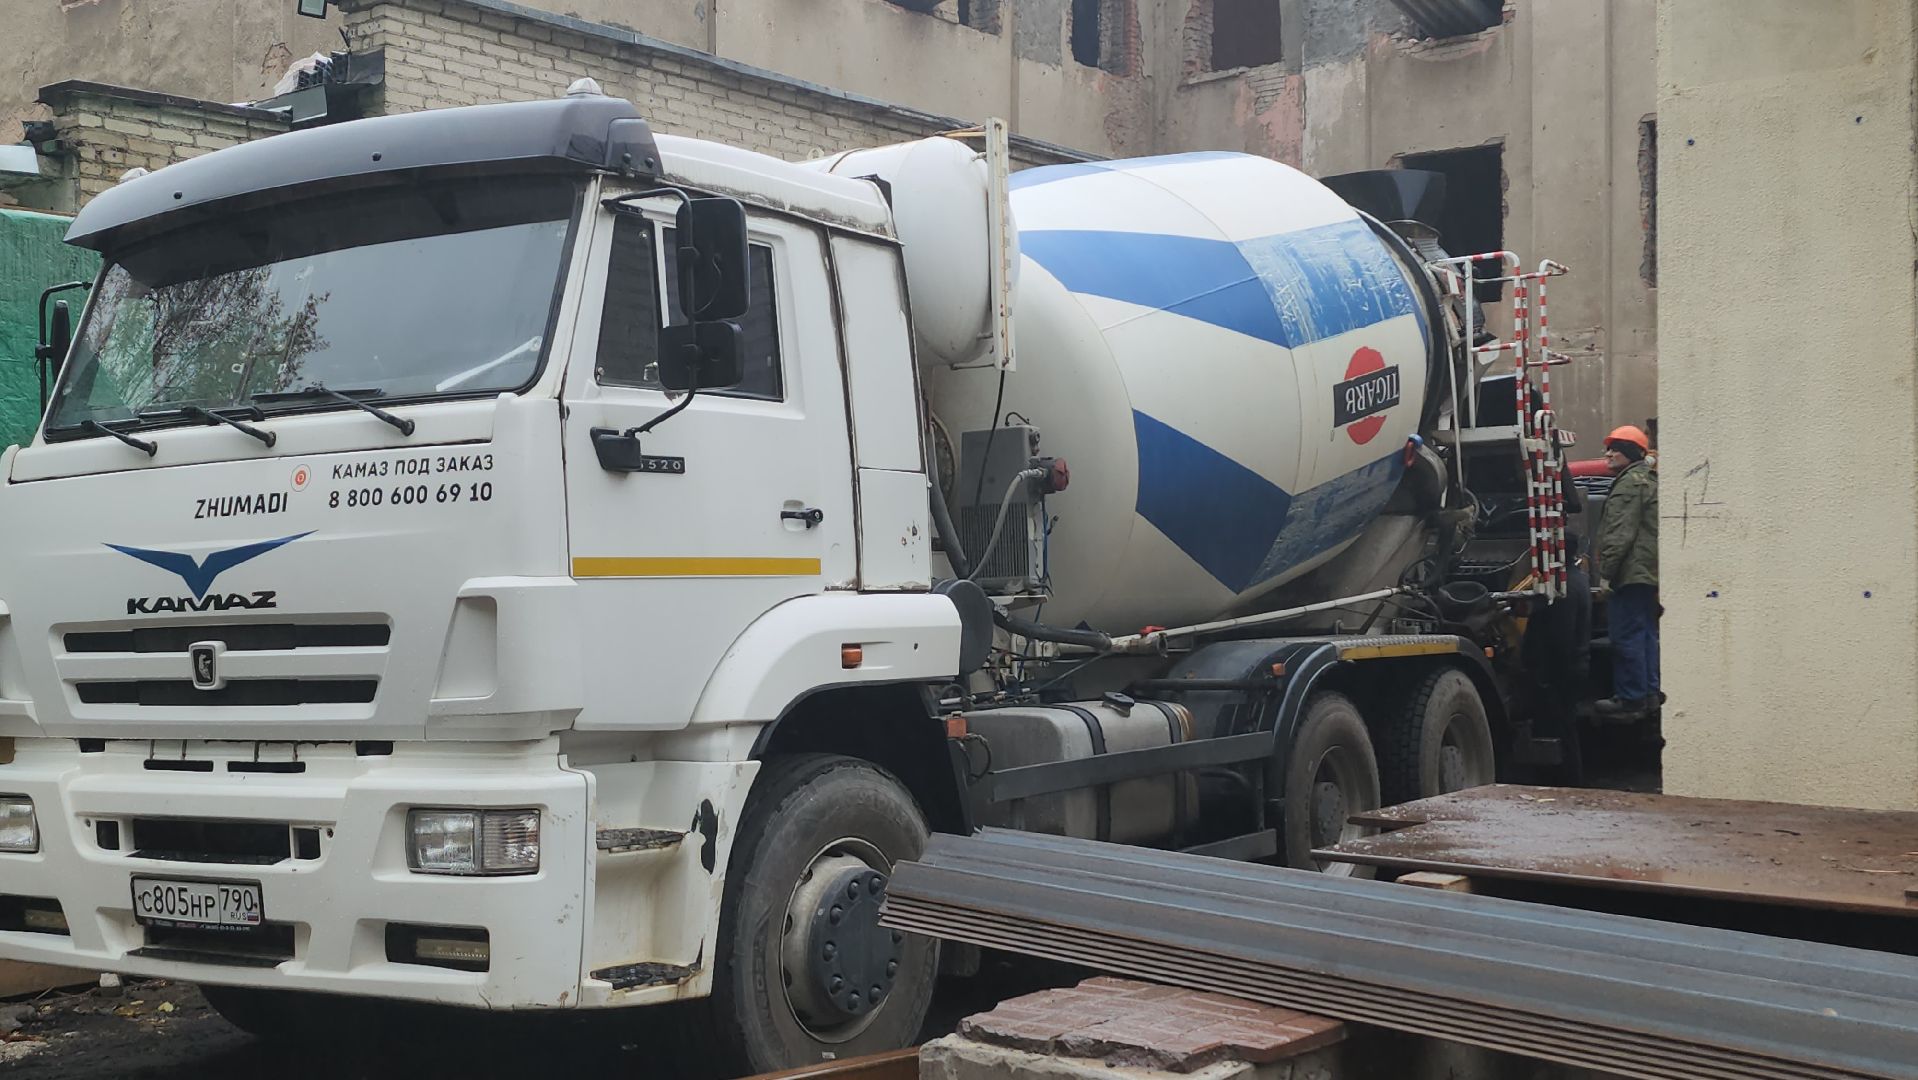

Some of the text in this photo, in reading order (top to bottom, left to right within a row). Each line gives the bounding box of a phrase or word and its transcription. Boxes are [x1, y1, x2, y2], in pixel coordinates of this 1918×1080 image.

[332, 454, 493, 479] КАМАЗ ПОД ЗАКАЗ
[640, 460, 681, 470] 520
[194, 491, 288, 519] ZHUMADI
[329, 482, 492, 508] 8 800 600 69 10
[127, 591, 277, 615] KAMAZ
[220, 888, 254, 911] 790
[230, 911, 247, 920] RUS
